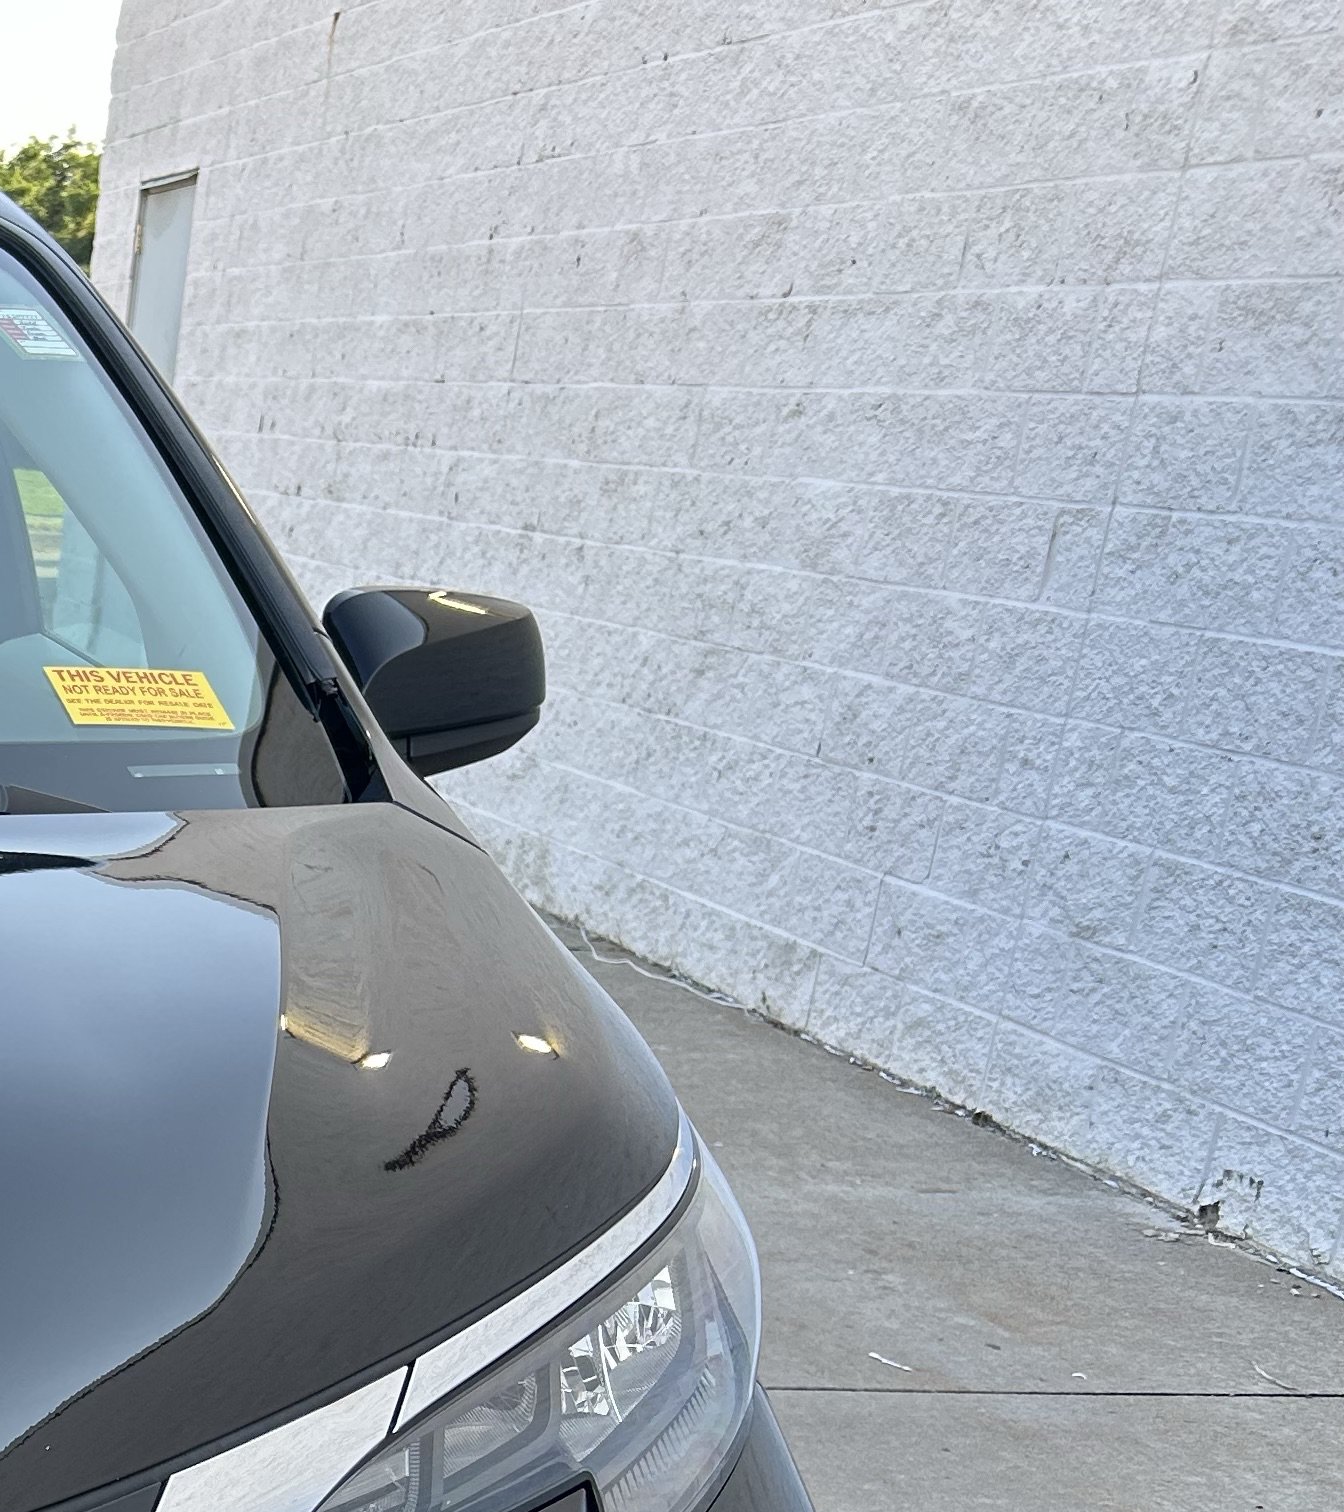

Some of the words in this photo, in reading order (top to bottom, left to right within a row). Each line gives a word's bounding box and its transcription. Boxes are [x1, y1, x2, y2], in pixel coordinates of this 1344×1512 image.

[51, 669, 105, 684] THIS
[106, 670, 199, 687] VEHICLE
[62, 684, 91, 696] NOT
[94, 685, 137, 697] READY
[141, 686, 168, 698] FOR
[170, 687, 205, 699] SALE
